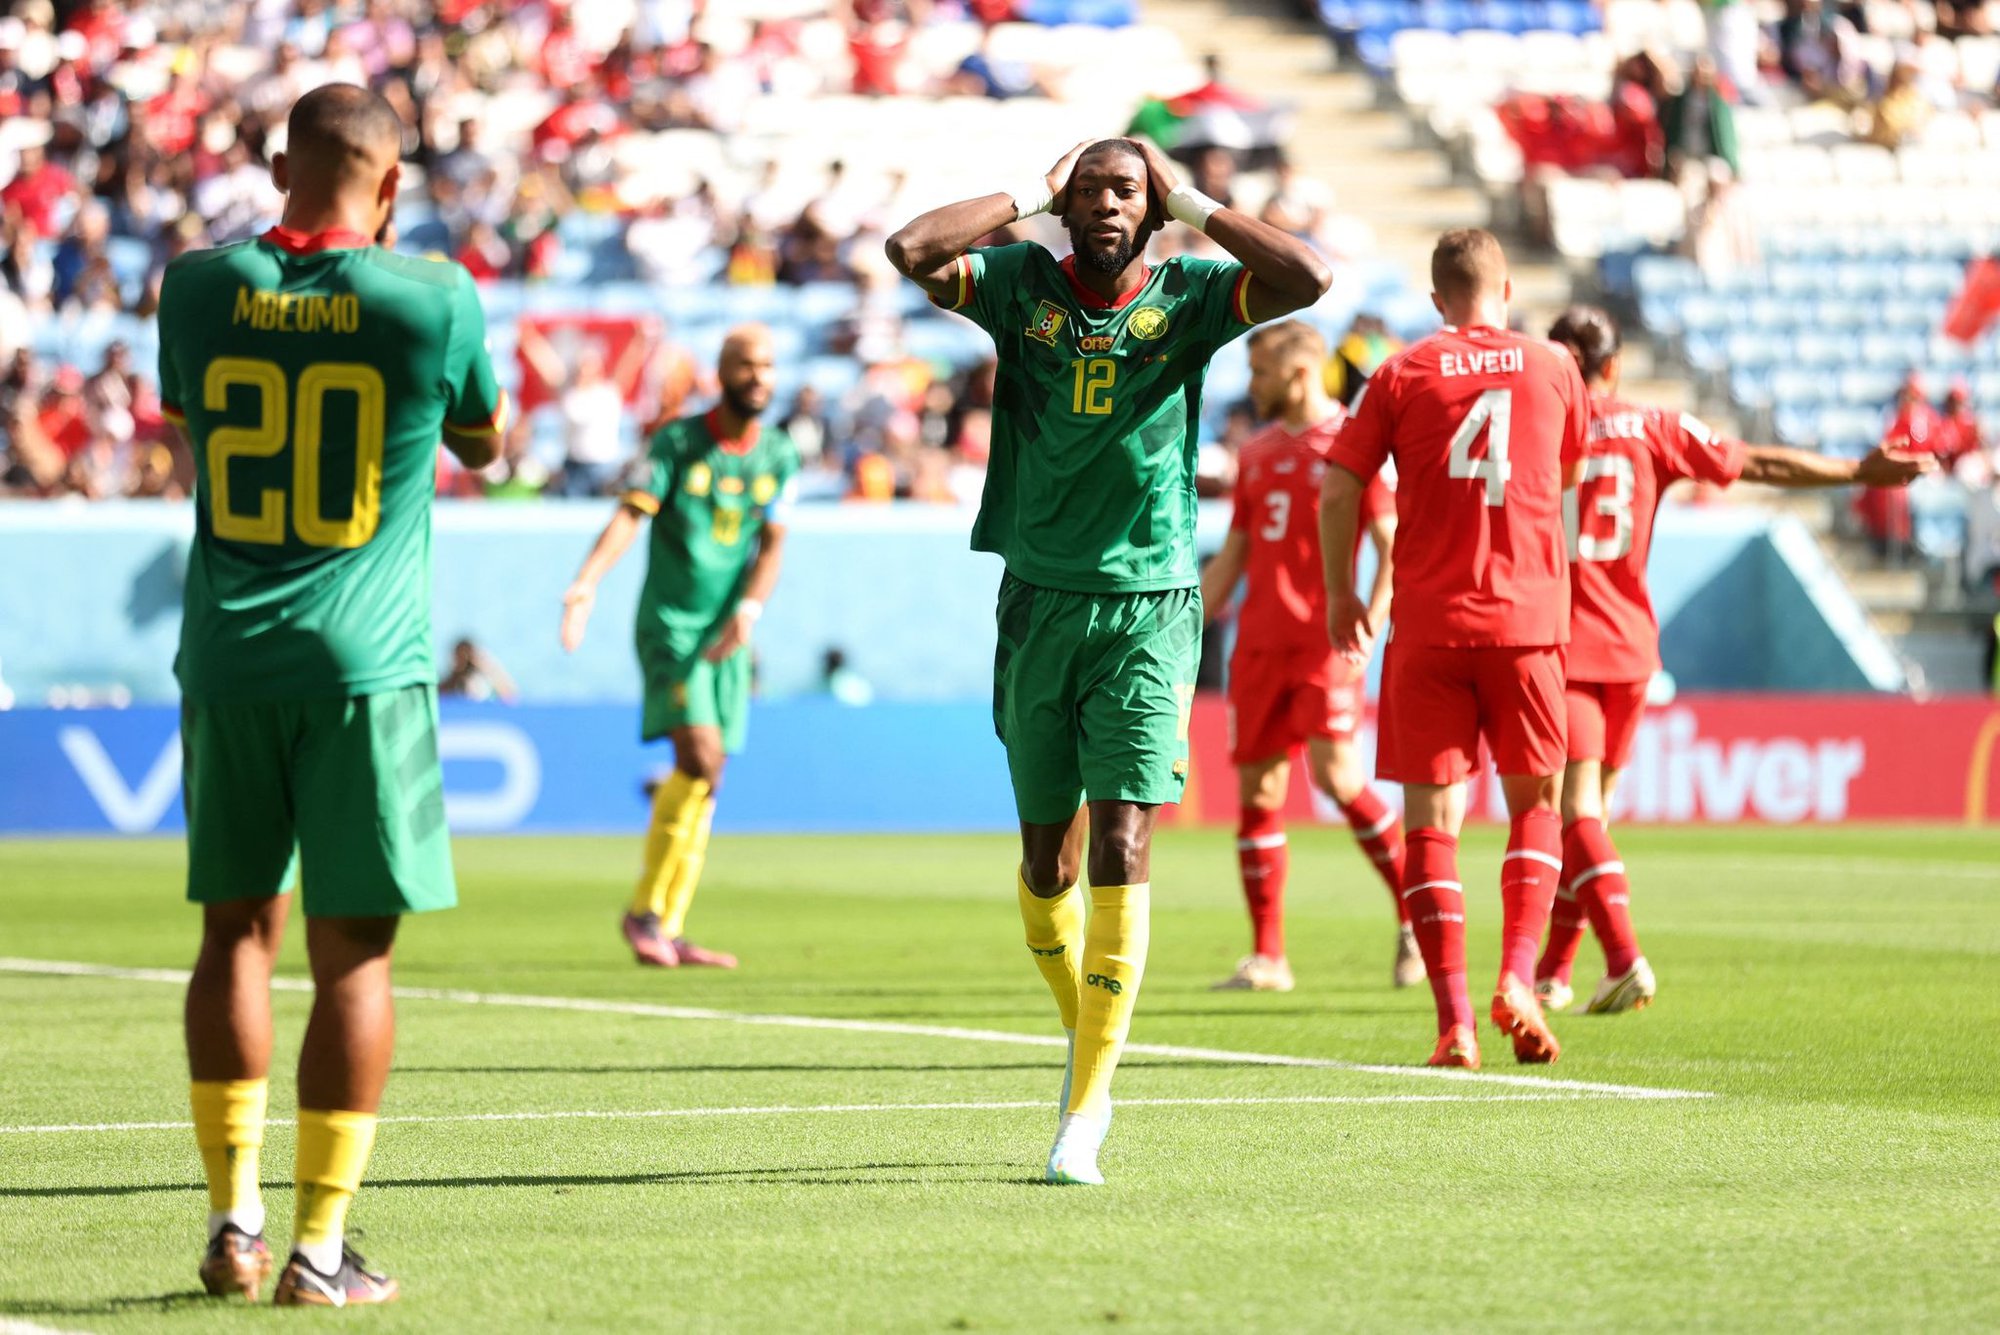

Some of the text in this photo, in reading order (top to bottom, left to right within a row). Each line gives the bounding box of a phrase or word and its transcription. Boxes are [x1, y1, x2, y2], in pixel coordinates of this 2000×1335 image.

[233, 285, 360, 334] MBEUMO
[1081, 337, 1114, 350] one
[1440, 347, 1524, 377] ELVEDI
[1071, 358, 1116, 415] 12
[204, 356, 386, 548] 20
[1448, 388, 1512, 507] 4
[1261, 491, 1291, 541] 3
[1087, 973, 1122, 996] one
